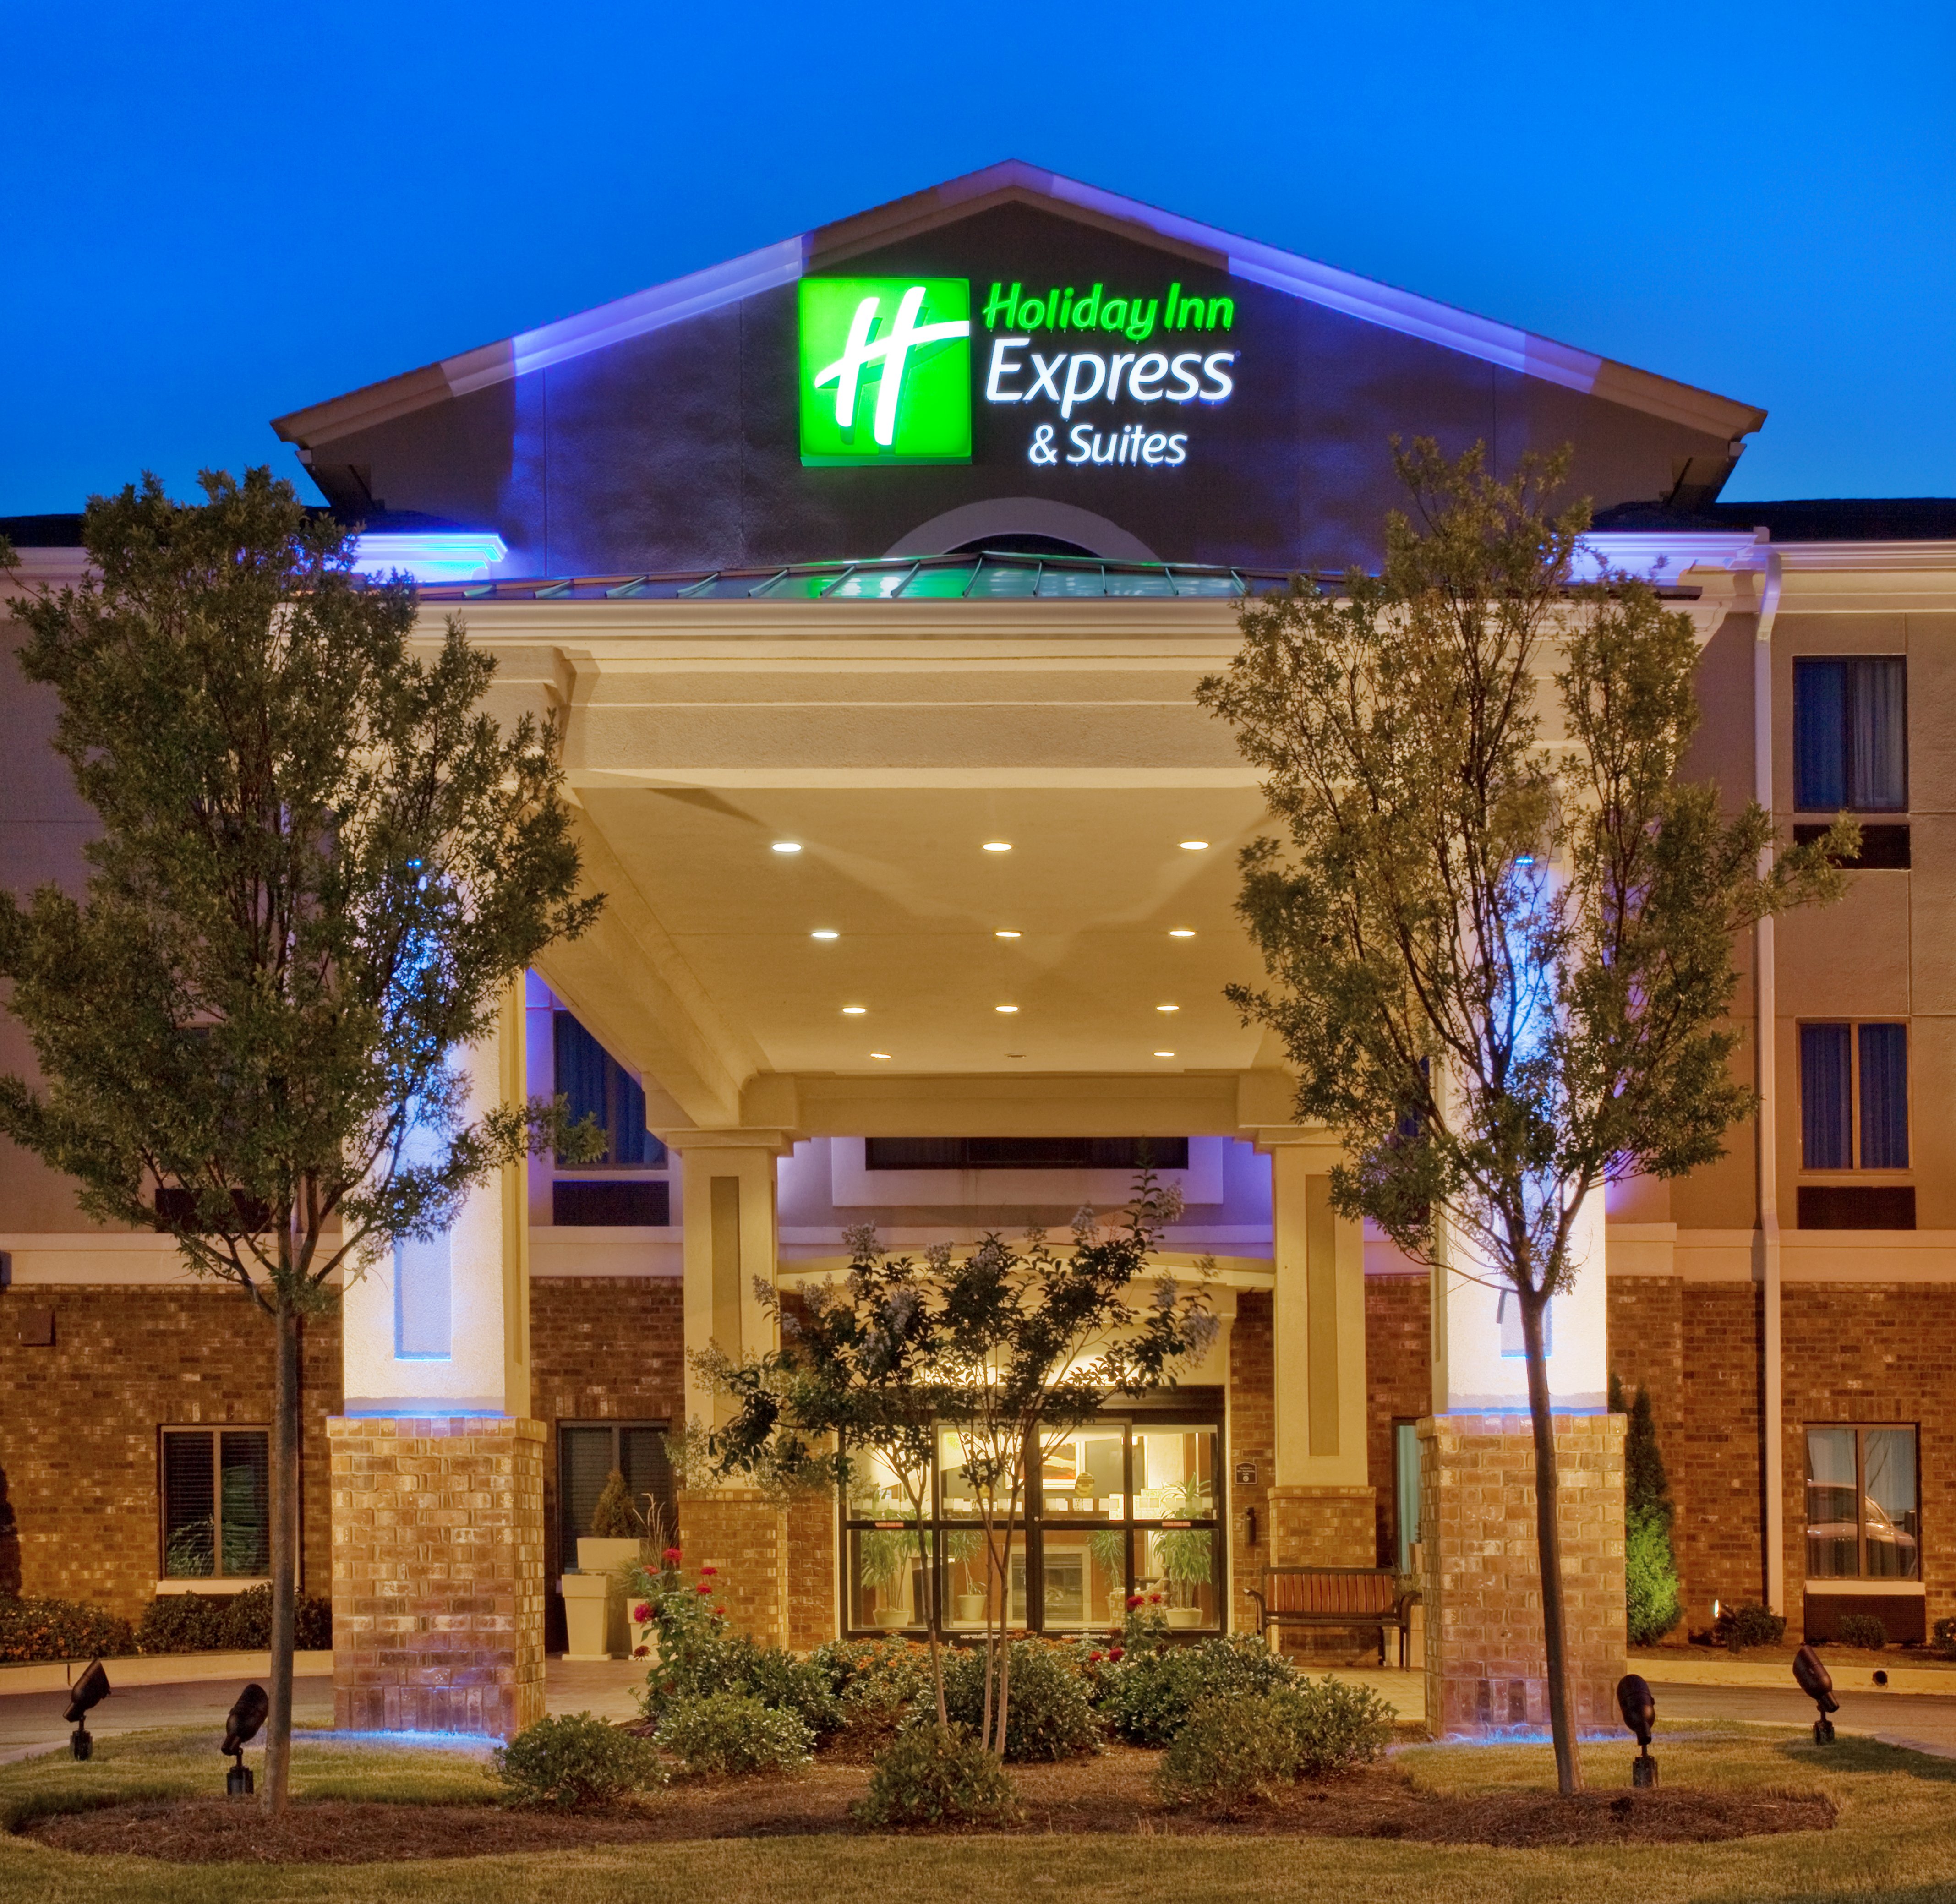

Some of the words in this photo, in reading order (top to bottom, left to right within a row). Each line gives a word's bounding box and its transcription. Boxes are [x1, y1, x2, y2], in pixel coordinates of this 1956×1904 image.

[983, 282, 1158, 343] Holiday
[1164, 282, 1234, 328] Inn
[985, 338, 1235, 419] Express
[1029, 424, 1058, 464] &
[1067, 424, 1187, 464] Suites
